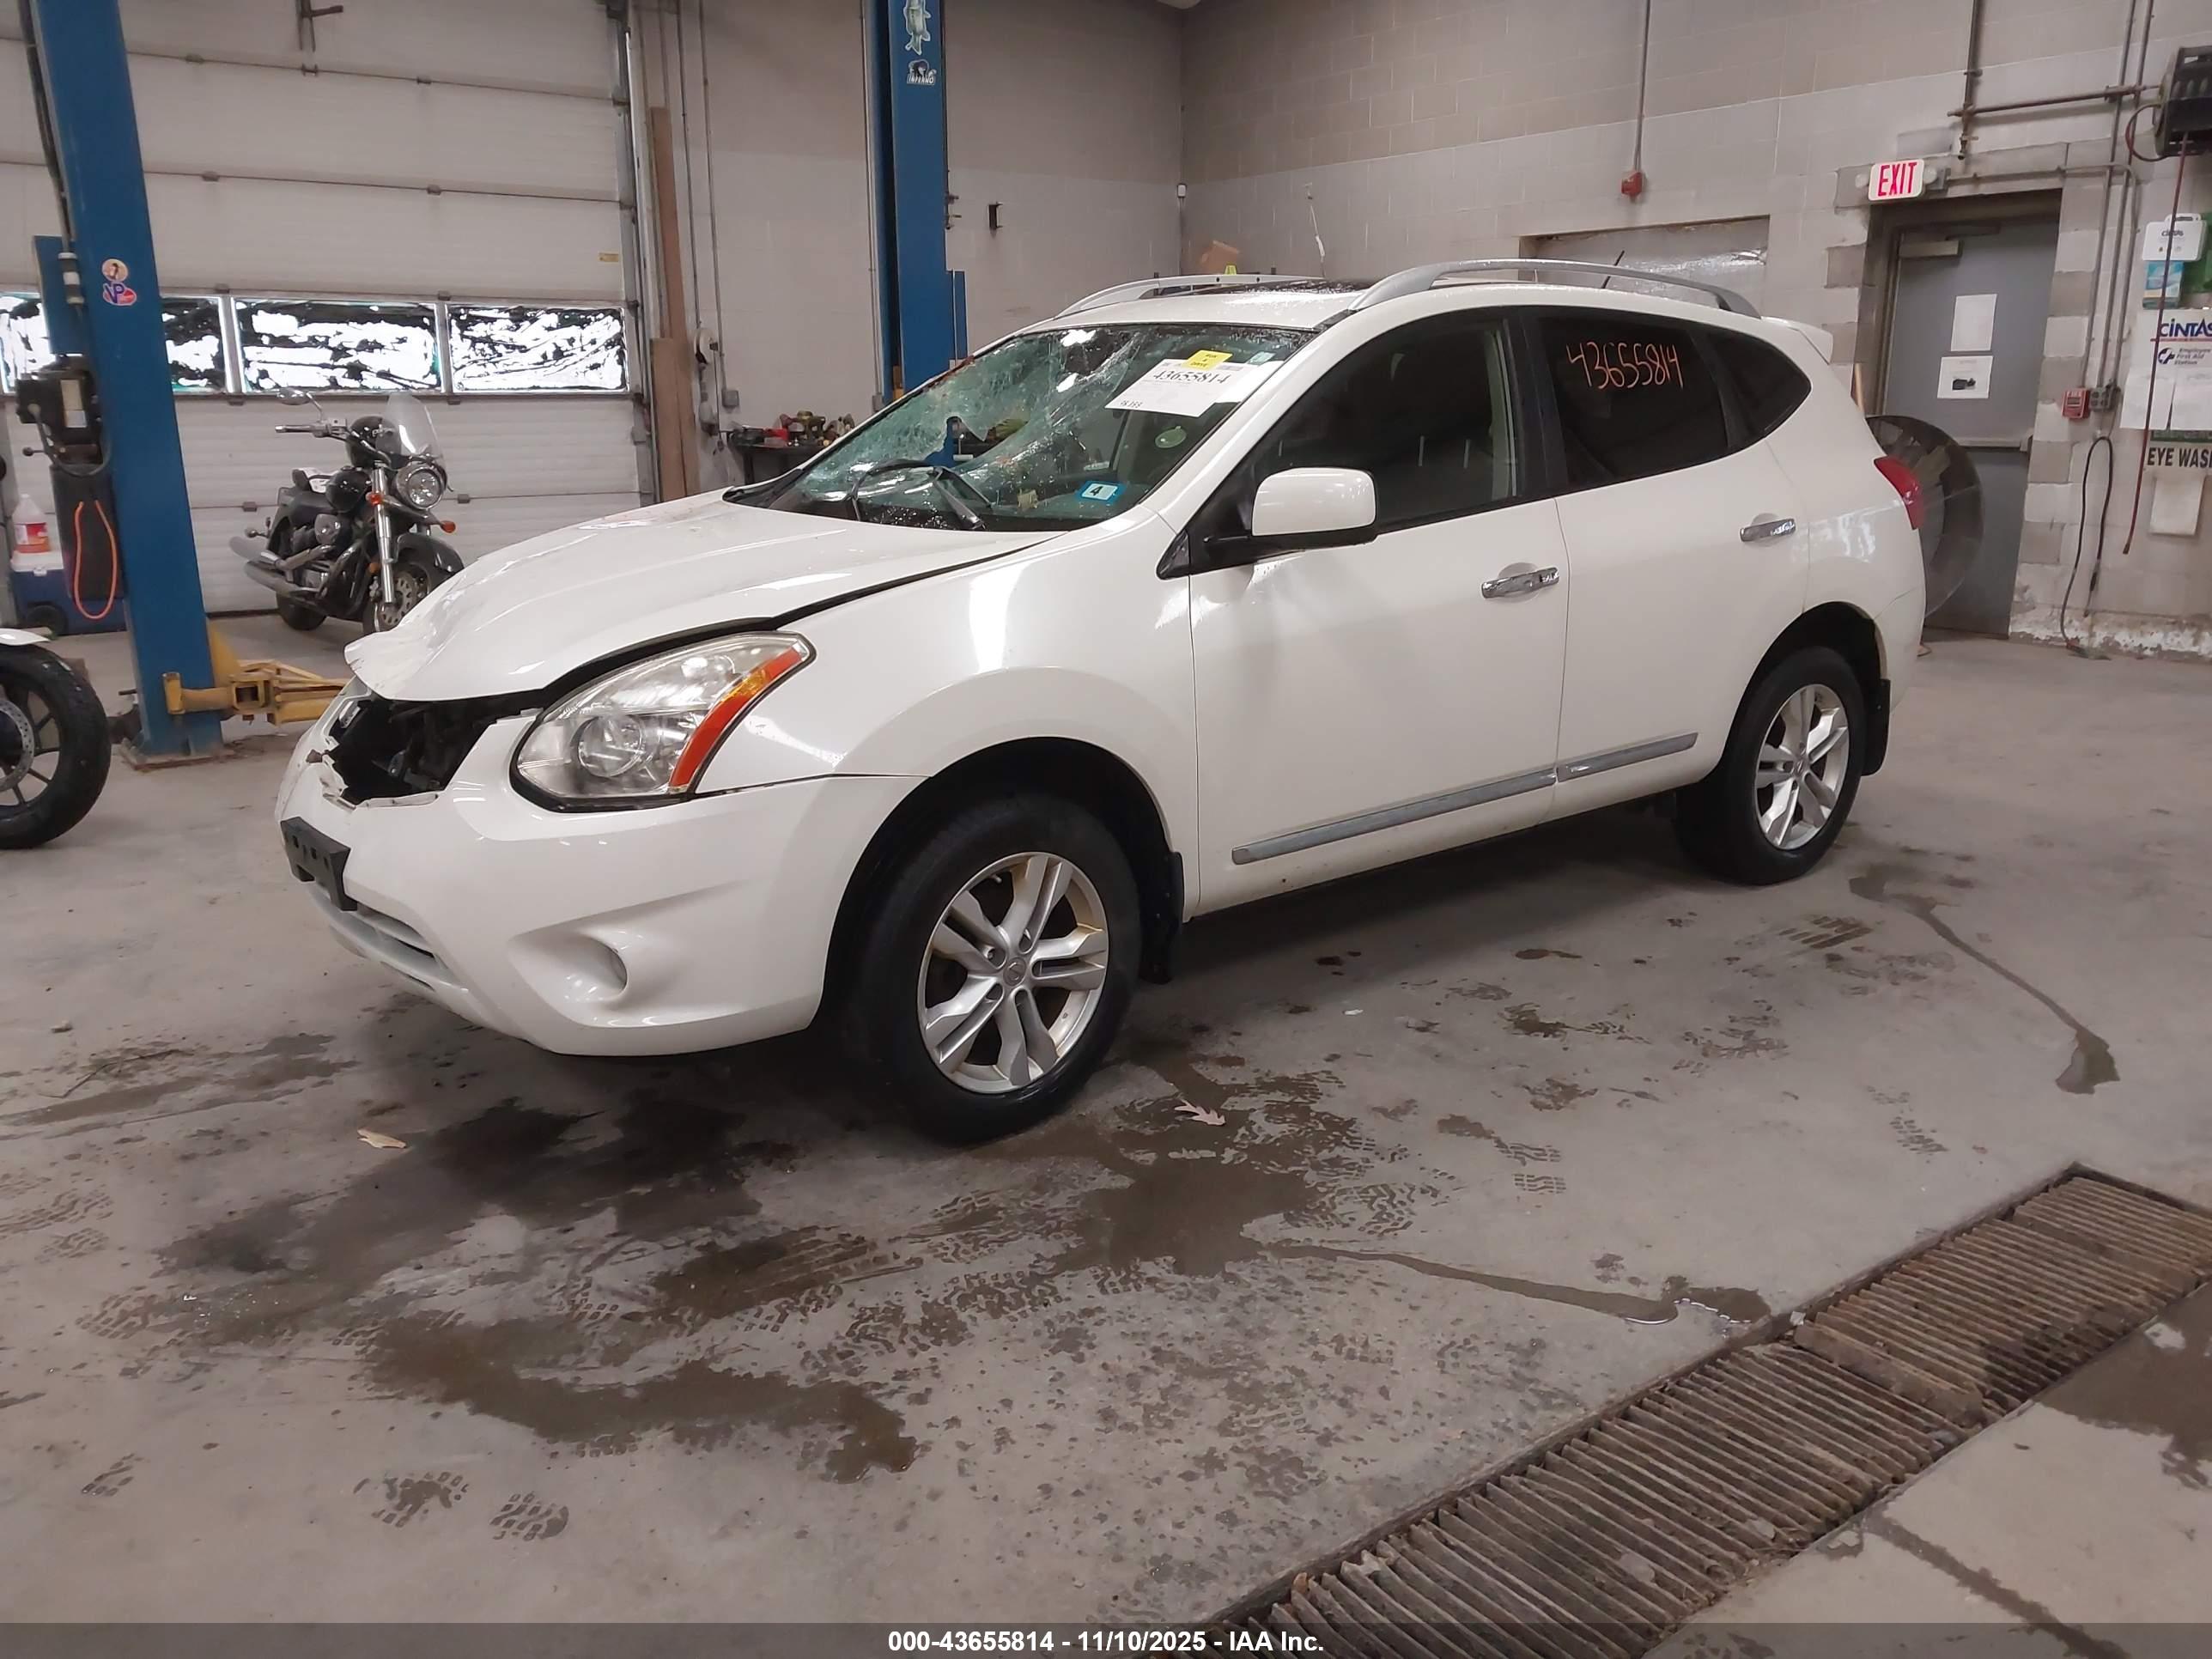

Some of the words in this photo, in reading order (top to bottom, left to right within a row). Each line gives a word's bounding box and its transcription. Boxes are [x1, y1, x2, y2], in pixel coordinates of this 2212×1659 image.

[1878, 161, 1917, 197] EXIT
[1565, 342, 1684, 389] 43655814
[1153, 370, 1231, 384] 43655814
[2147, 447, 2174, 466] EYE
[1090, 486, 1103, 496] 4
